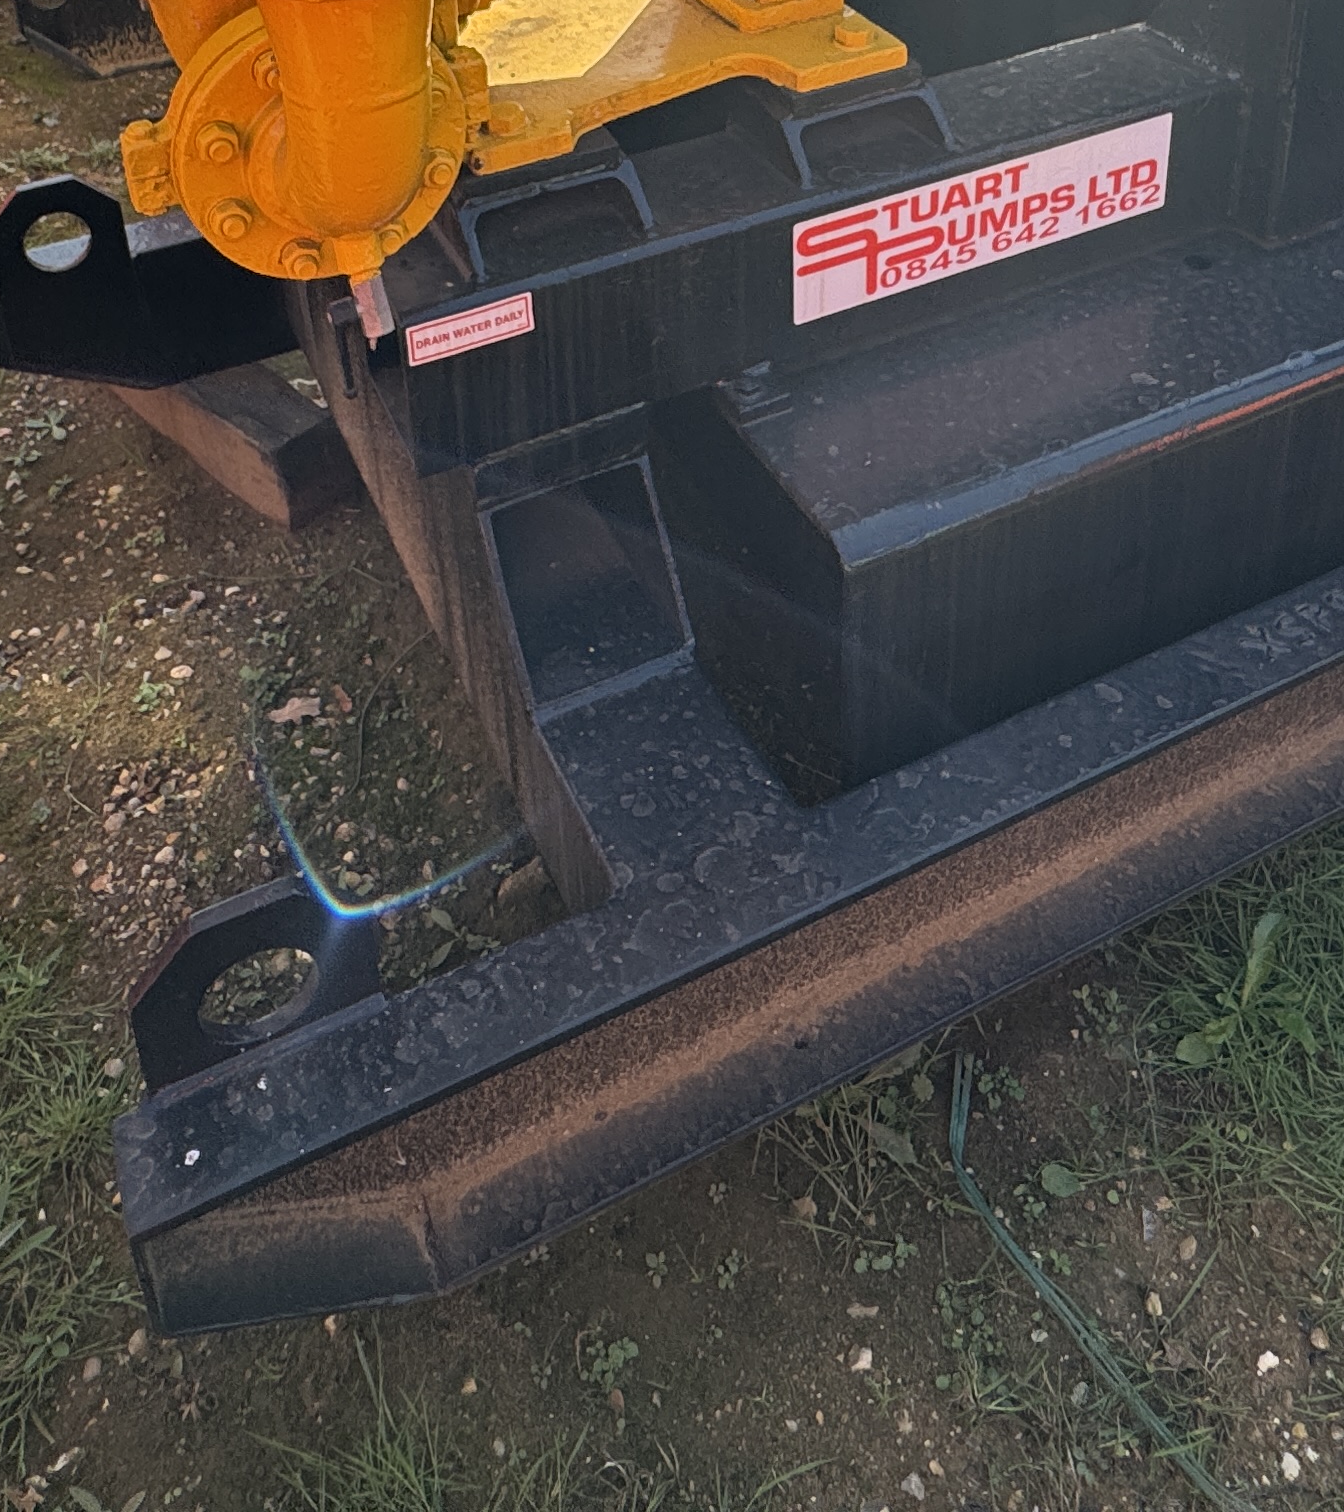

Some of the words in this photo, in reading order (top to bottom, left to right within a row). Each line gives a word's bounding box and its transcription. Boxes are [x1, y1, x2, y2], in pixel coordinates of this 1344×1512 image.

[796, 162, 1031, 277] STUART
[864, 182, 1076, 295] PUMPS
[1086, 158, 1158, 202] LTD
[879, 240, 977, 289] 0845
[991, 216, 1060, 253] 642
[1075, 183, 1161, 226] 1662
[415, 331, 450, 350] DRAIN
[453, 319, 492, 338] WATER
[495, 309, 525, 327] DAILY
